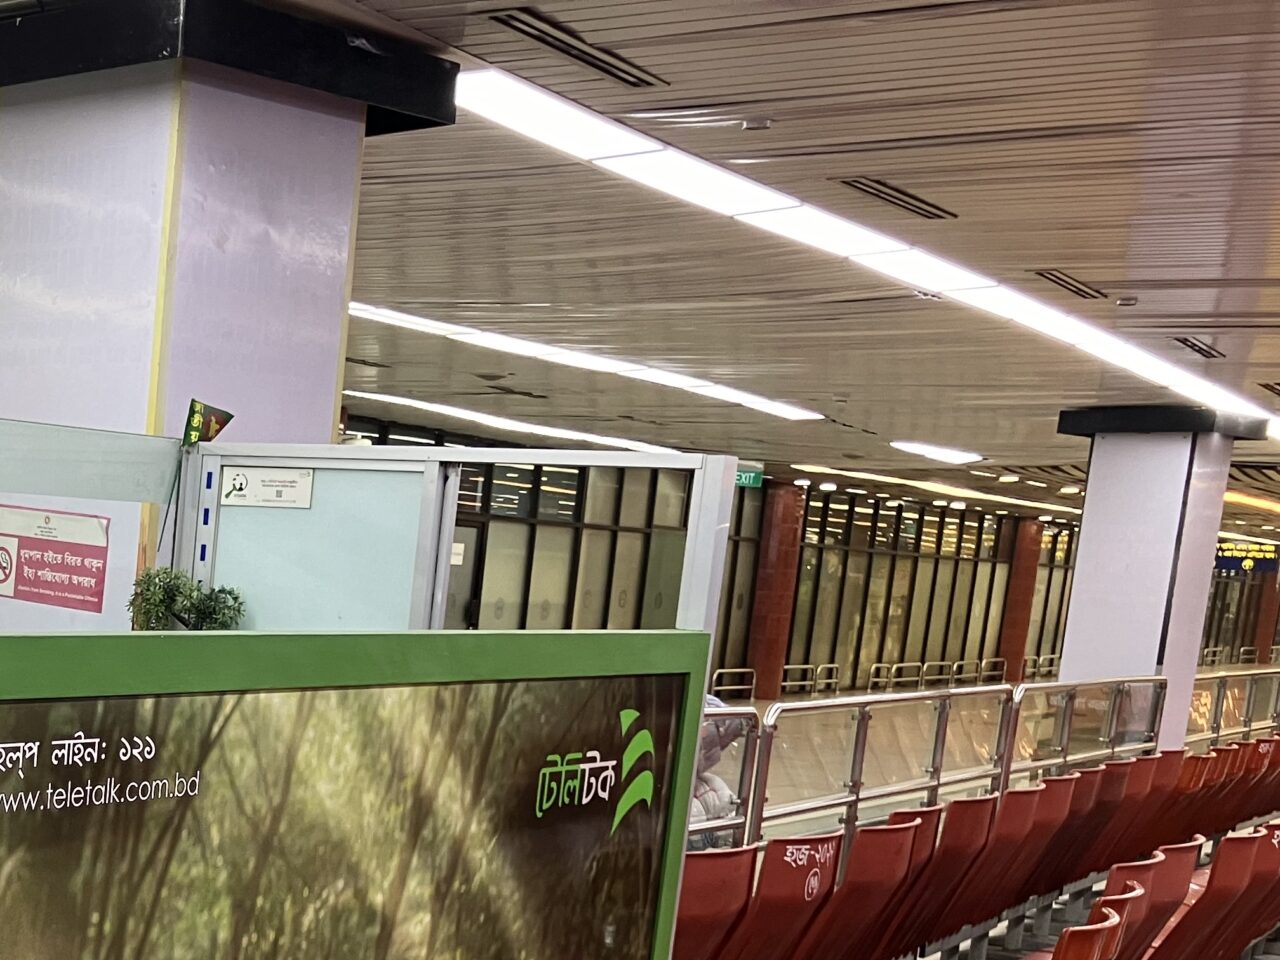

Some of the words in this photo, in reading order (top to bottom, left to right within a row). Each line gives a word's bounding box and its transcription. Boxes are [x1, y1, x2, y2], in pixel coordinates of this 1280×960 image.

[735, 471, 756, 484] EXIT
[119, 736, 156, 762] ১২১
[536, 750, 617, 818] টেলিটক
